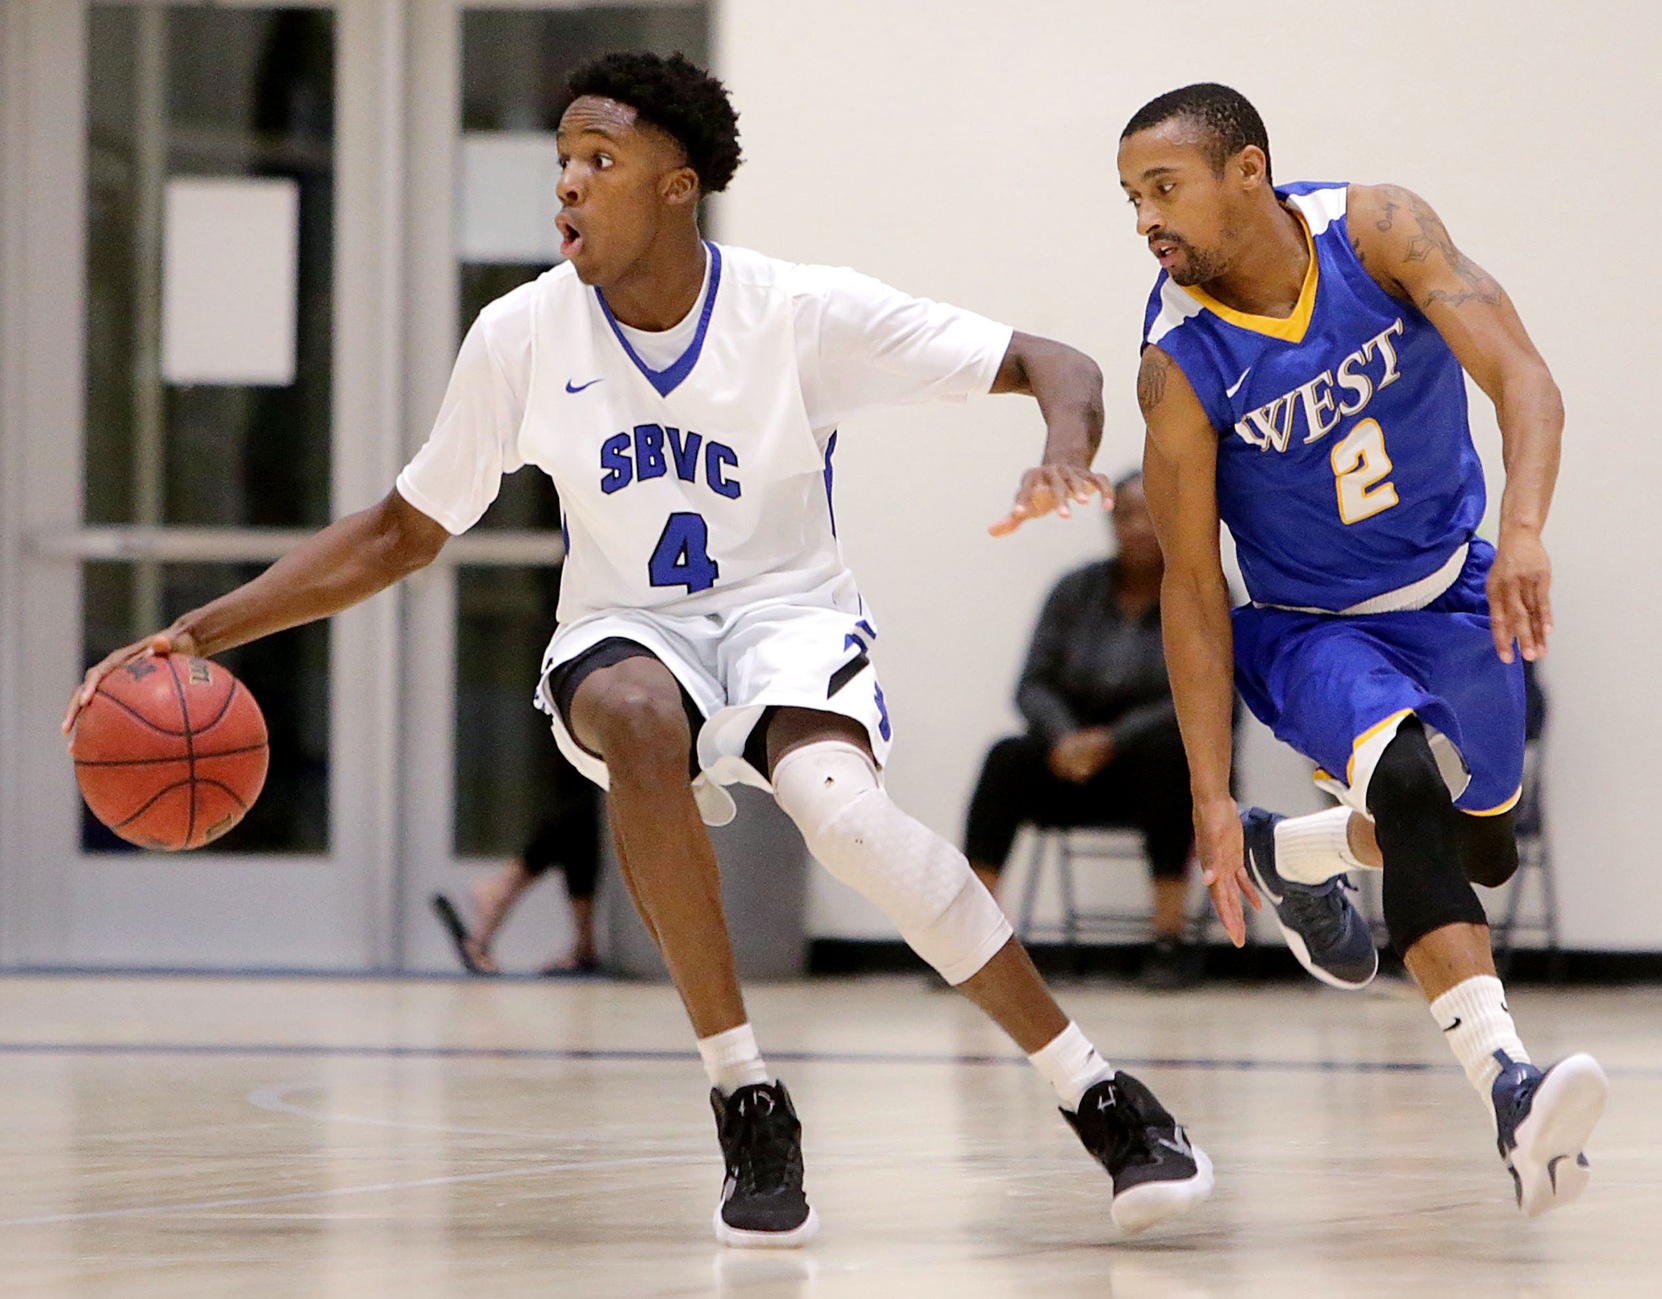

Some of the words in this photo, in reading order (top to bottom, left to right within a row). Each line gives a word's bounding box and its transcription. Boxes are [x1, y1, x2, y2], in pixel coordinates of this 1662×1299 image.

[1234, 317, 1404, 452] WEST
[600, 423, 741, 500] SBVC
[1330, 417, 1399, 525] 2
[647, 511, 719, 595] 4
